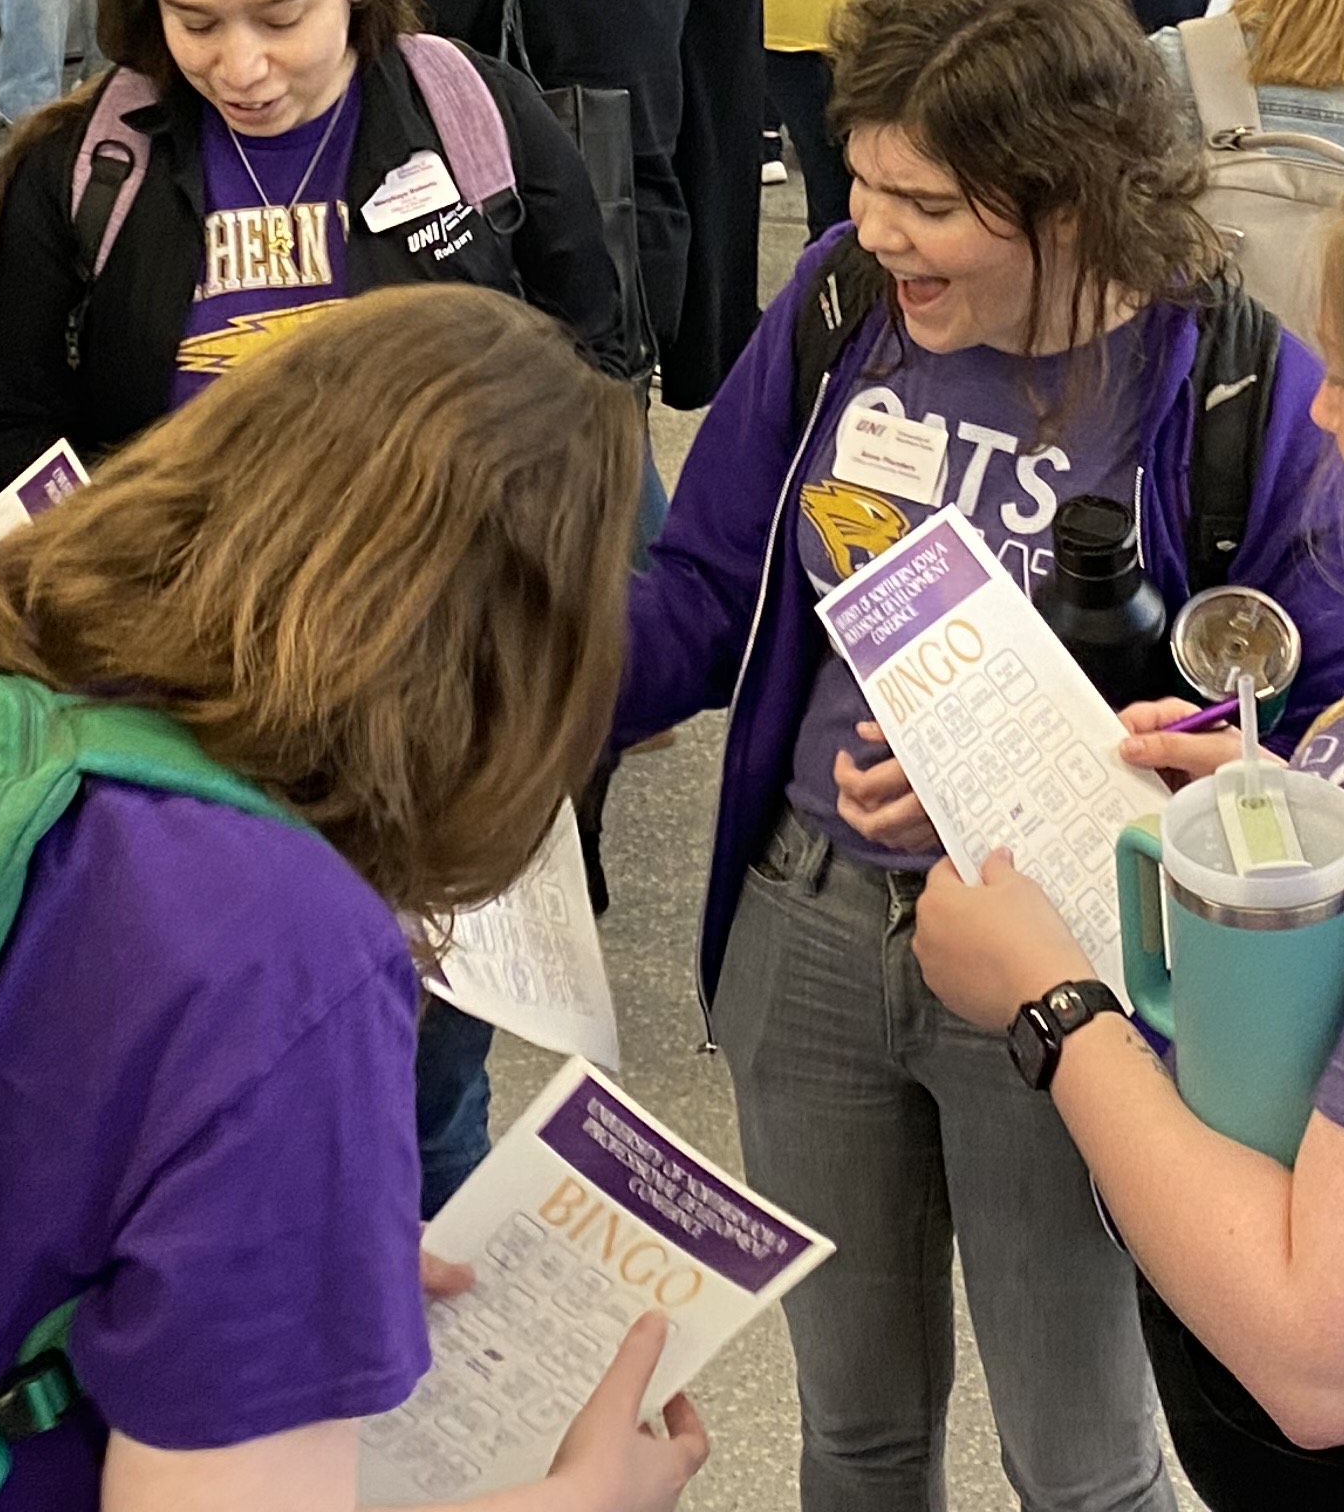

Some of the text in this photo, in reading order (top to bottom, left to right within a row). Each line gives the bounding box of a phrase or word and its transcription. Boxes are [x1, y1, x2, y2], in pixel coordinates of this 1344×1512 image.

[192, 202, 332, 302] HERN
[407, 221, 440, 253] UNI
[876, 619, 984, 725] BINGO
[538, 1176, 702, 1307] BINGO
